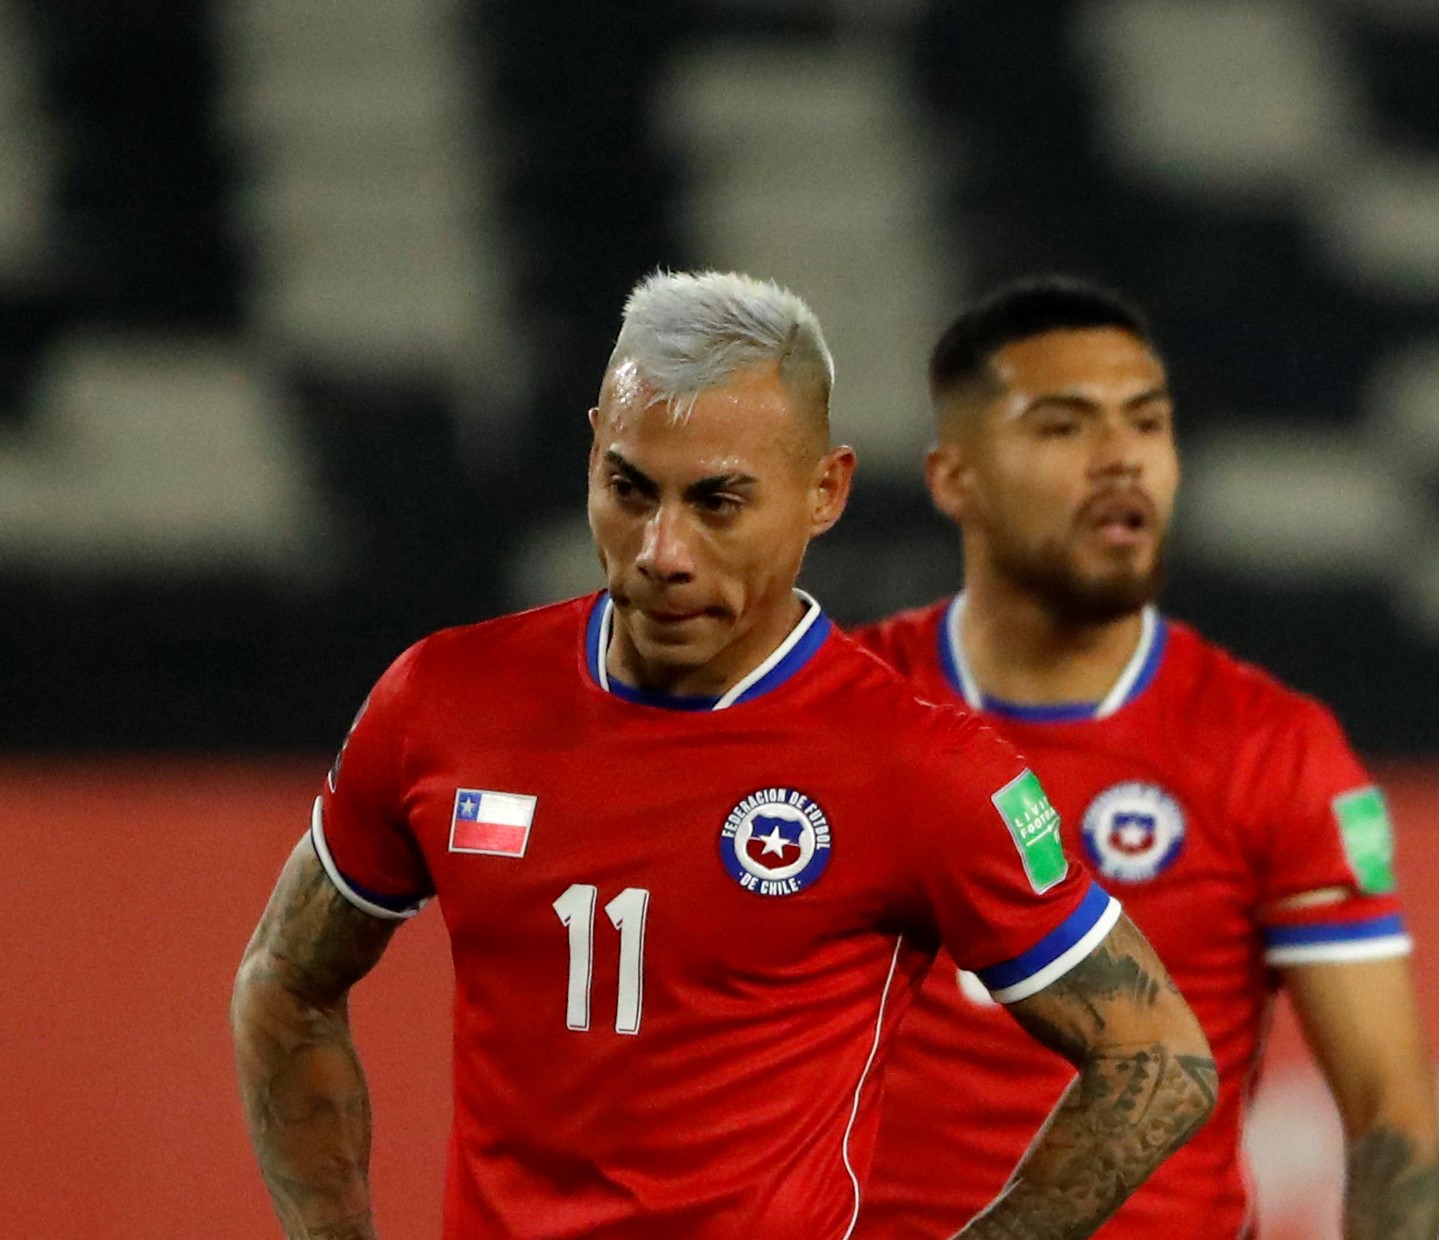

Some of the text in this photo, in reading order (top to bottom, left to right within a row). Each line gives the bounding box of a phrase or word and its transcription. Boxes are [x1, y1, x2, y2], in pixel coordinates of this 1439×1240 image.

[721, 787, 831, 850] FEDERACION DE FUTBOL
[740, 872, 799, 896] DE CHILE
[552, 883, 651, 1035] 11
